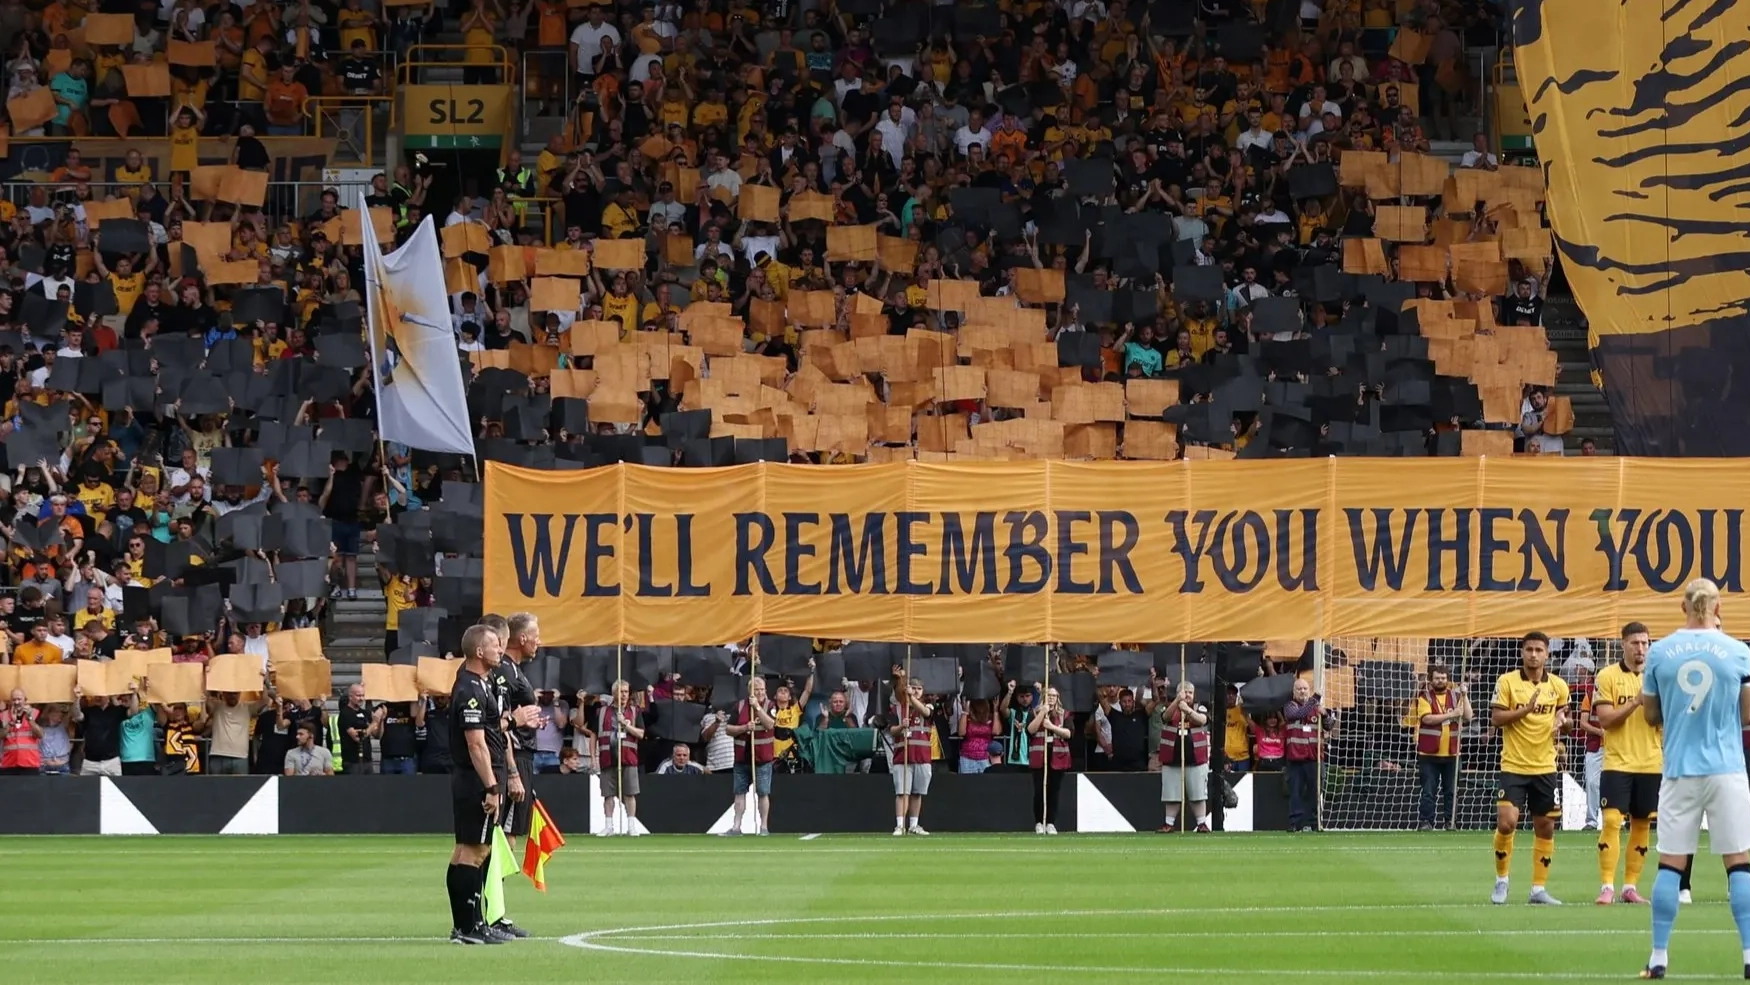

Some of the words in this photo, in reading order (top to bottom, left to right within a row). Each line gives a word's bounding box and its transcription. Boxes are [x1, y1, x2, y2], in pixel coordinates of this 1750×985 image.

[429, 98, 485, 124] SL2
[507, 513, 710, 598] WE'LL
[735, 511, 1143, 596] REMEMBER
[1167, 509, 1318, 594] YOU
[1345, 508, 1568, 592] WHEN
[1592, 509, 1742, 594] YOU
[1664, 641, 1729, 660] HAALAND
[1676, 660, 1714, 715] 9
[1553, 787, 1560, 805] 8
